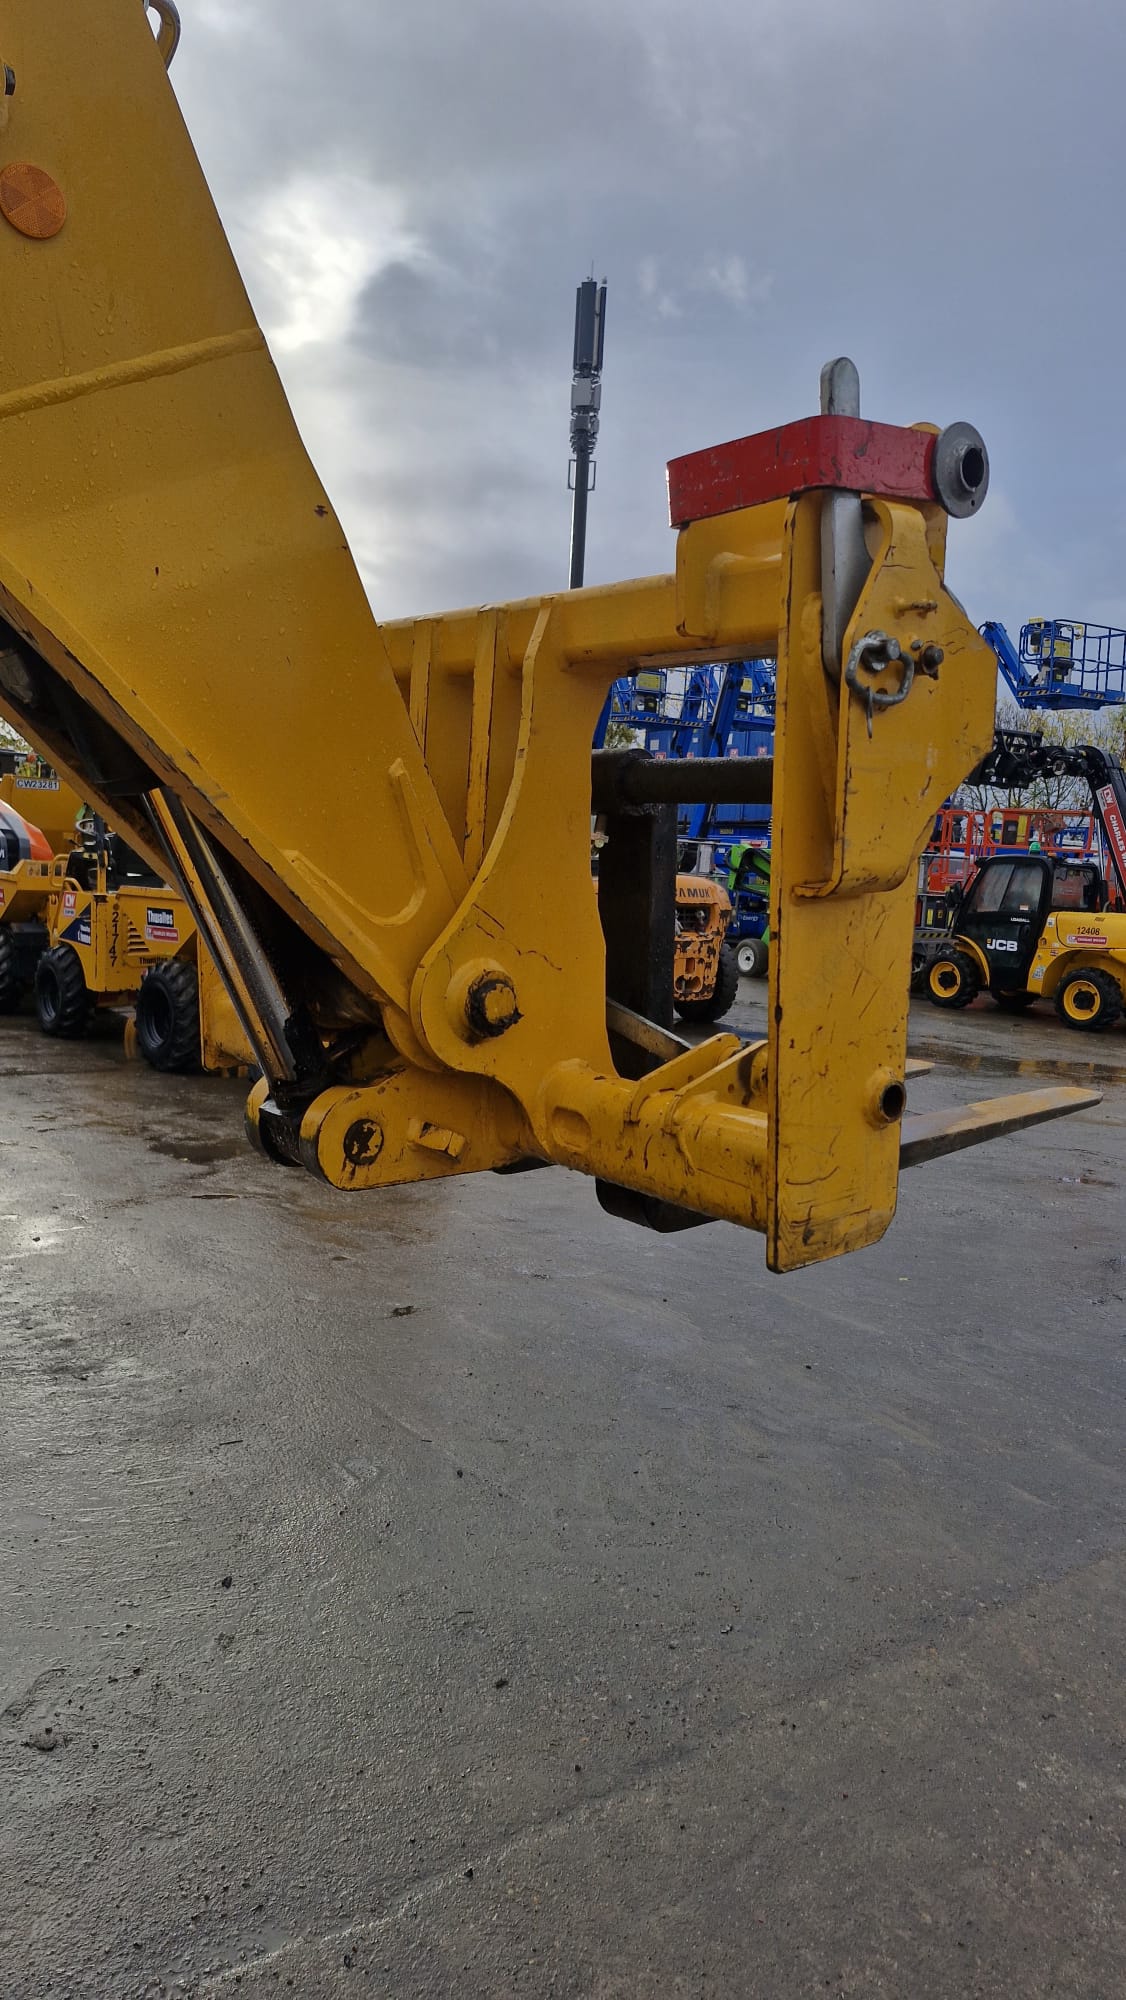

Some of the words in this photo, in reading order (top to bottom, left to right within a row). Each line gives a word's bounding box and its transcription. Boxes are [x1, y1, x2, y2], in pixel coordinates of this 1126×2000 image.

[1109, 814, 1126, 852] CHARLES
[676, 887, 711, 898] AMUK
[1076, 926, 1101, 936] 12408
[986, 938, 1018, 952] JCB
